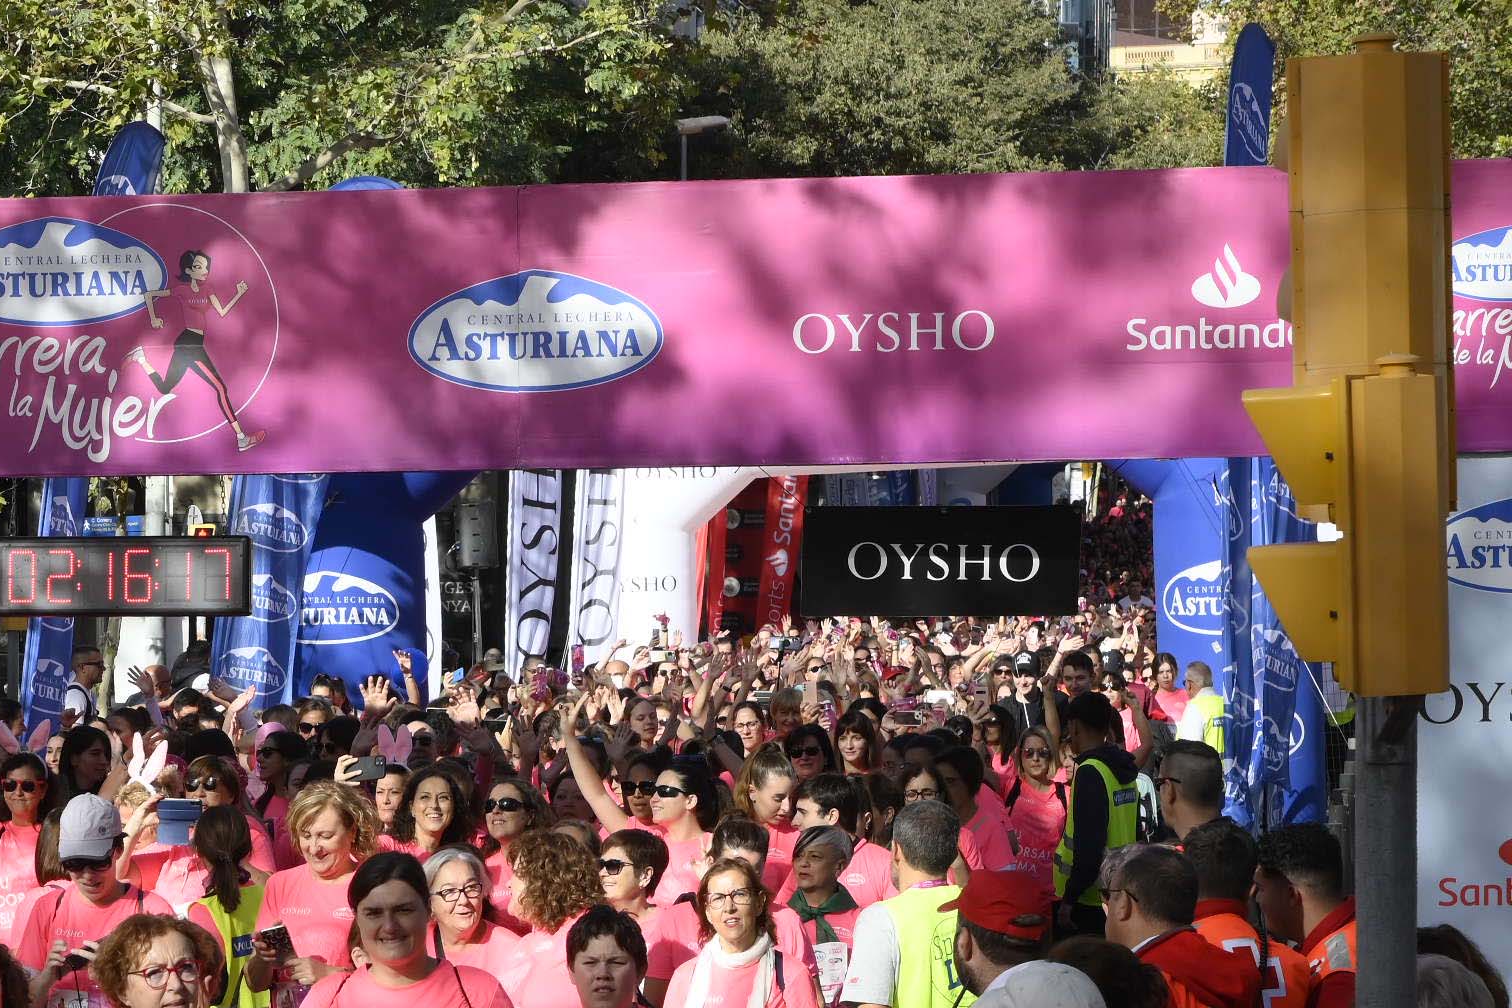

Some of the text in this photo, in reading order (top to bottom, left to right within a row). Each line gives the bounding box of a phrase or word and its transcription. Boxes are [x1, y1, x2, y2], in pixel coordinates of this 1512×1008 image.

[70, 253, 144, 266] LECHERA
[467, 310, 636, 327] CENTRAL LECHERA
[792, 309, 996, 354] OYSHO
[1126, 316, 1293, 351] Santand
[429, 317, 645, 362] ASTURIANA
[8, 379, 33, 418] la
[28, 368, 177, 464] Mujer
[7, 548, 231, 604] 02:16:17
[518, 470, 558, 658] OYSH
[578, 470, 618, 647] OYSH
[846, 541, 1042, 582] OYSHO
[336, 596, 386, 605] LECHERA
[619, 575, 678, 593] YSHO
[1186, 585, 1222, 594] CENTR
[299, 606, 390, 627] TURIANA
